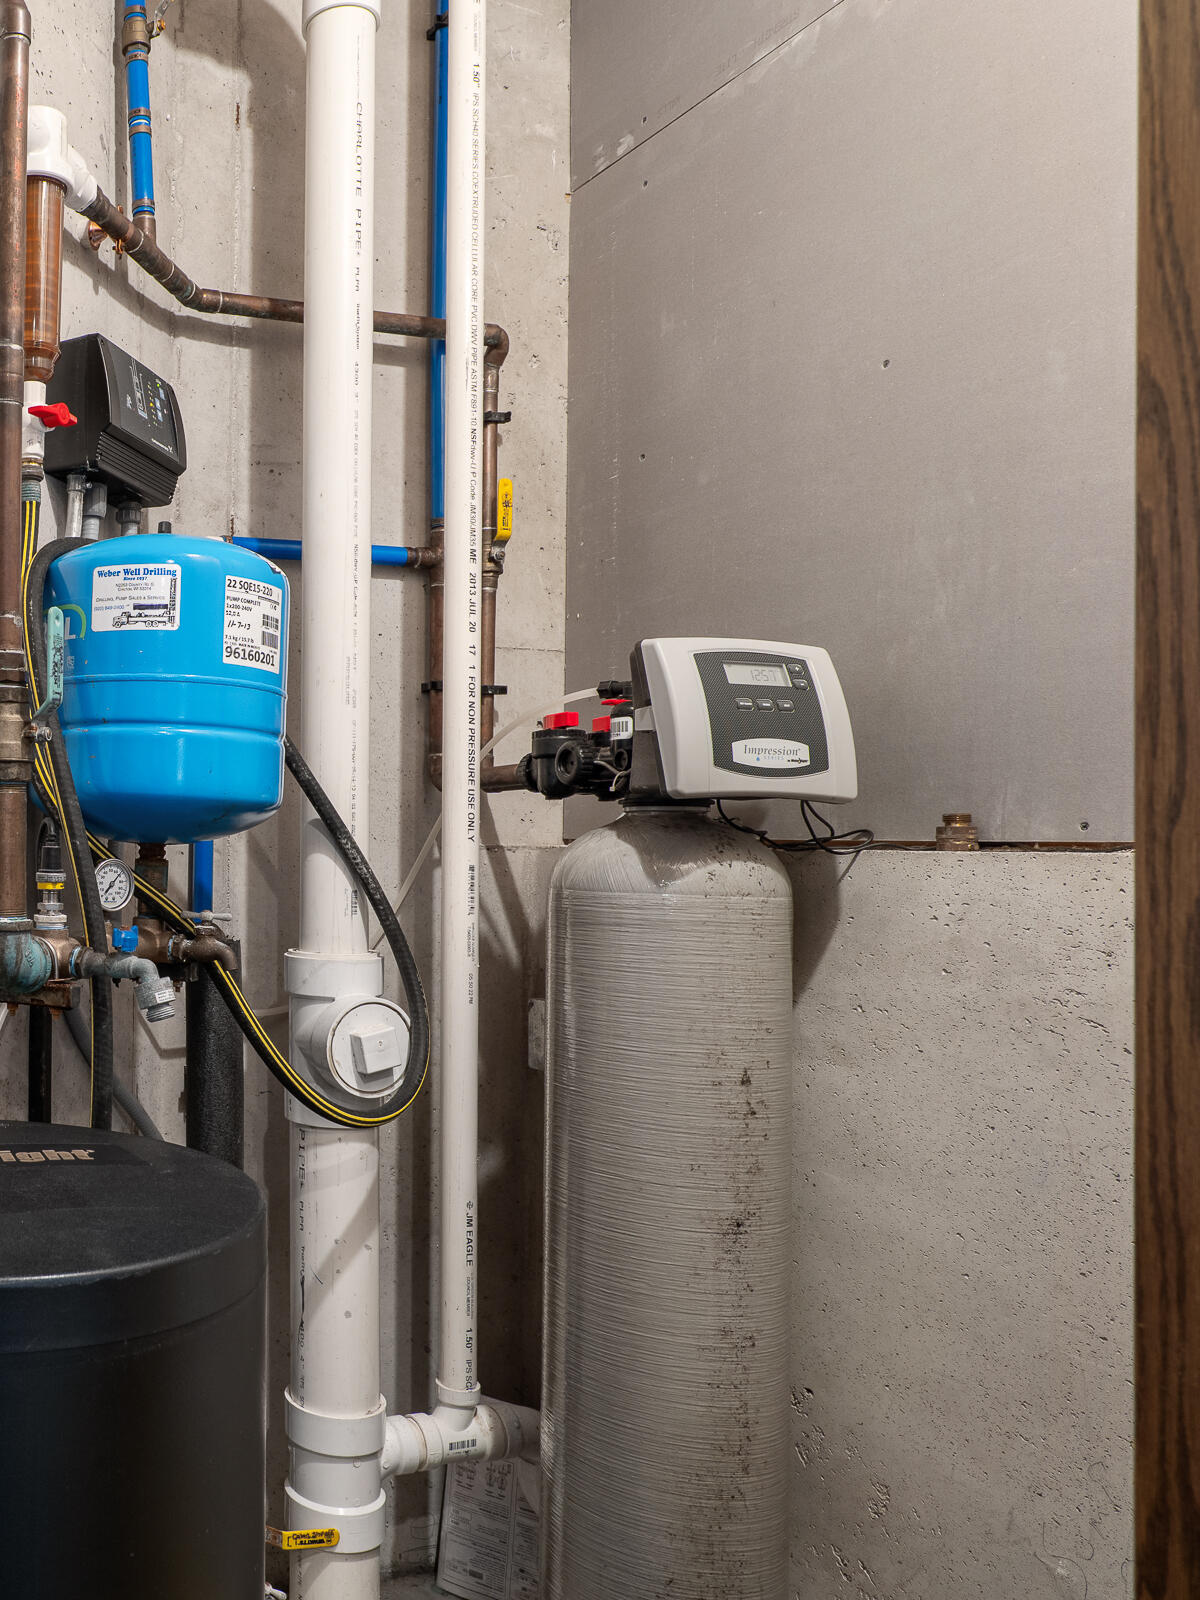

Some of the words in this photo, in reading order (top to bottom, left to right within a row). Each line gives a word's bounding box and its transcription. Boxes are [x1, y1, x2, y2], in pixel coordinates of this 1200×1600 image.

[472, 92, 480, 106] IPS
[143, 568, 176, 577] Drilling
[227, 579, 237, 589] 22
[239, 580, 272, 596] SQE15-220
[469, 621, 476, 632] 20
[225, 646, 274, 666] 96160201
[469, 644, 476, 656] 17
[744, 744, 798, 756] Impression
[466, 1212, 473, 1227] JM
